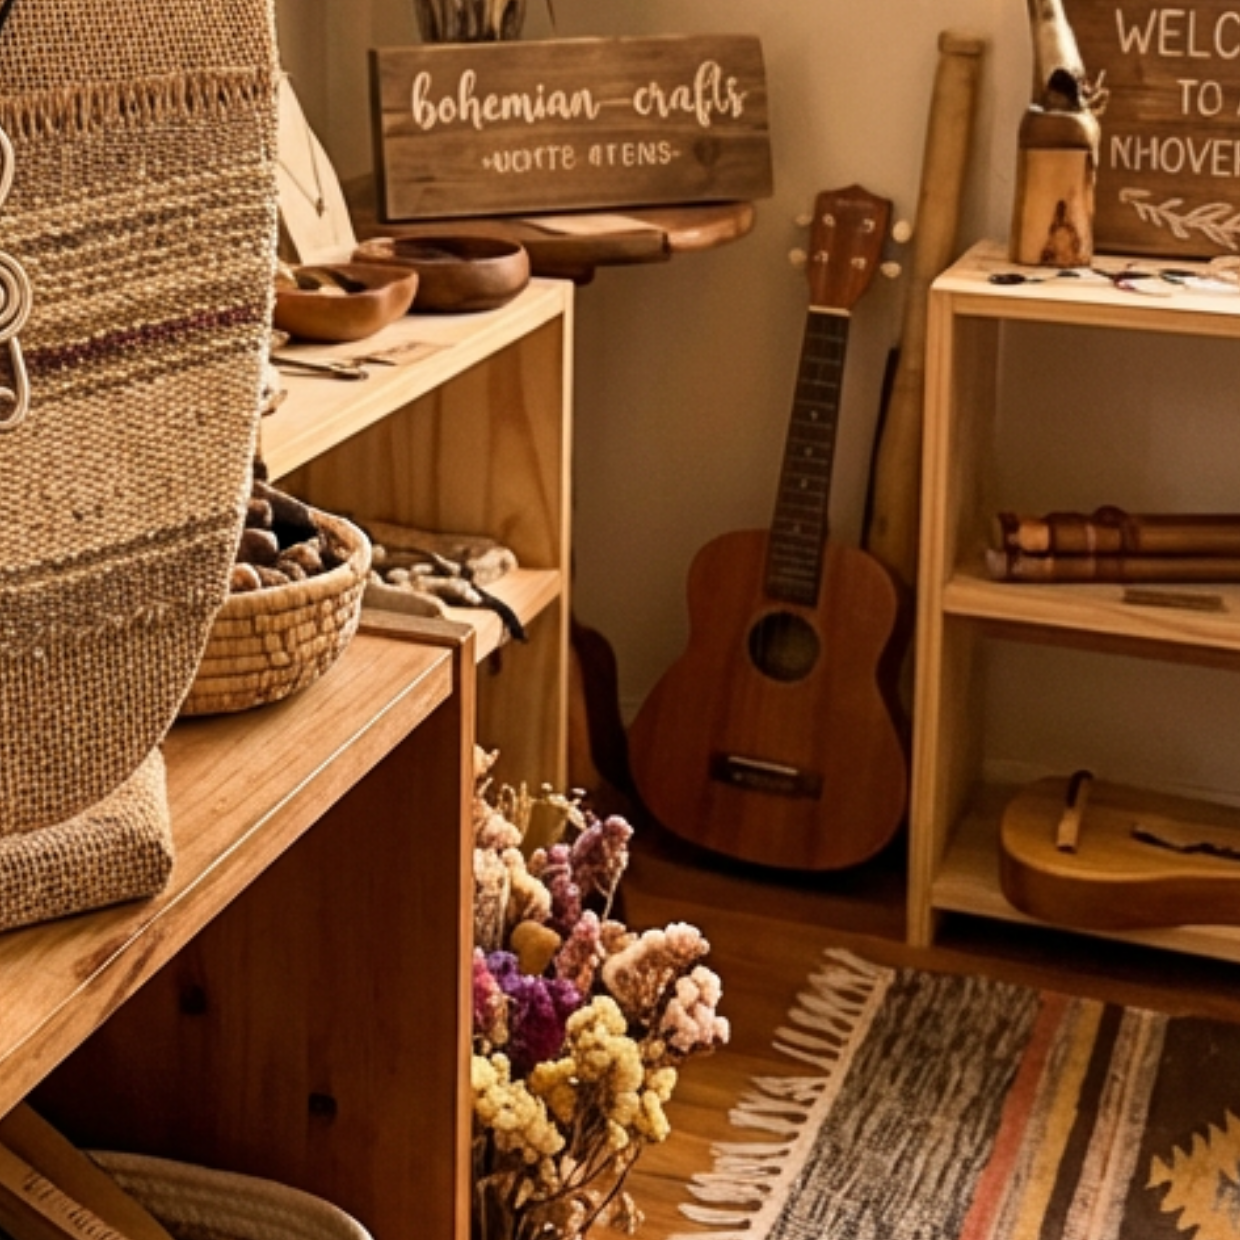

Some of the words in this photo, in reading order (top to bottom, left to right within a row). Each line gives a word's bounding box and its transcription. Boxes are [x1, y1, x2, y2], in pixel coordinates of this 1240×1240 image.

[411, 68, 603, 131] bohemian
[632, 59, 747, 128] crafts
[1176, 78, 1223, 117] TO
